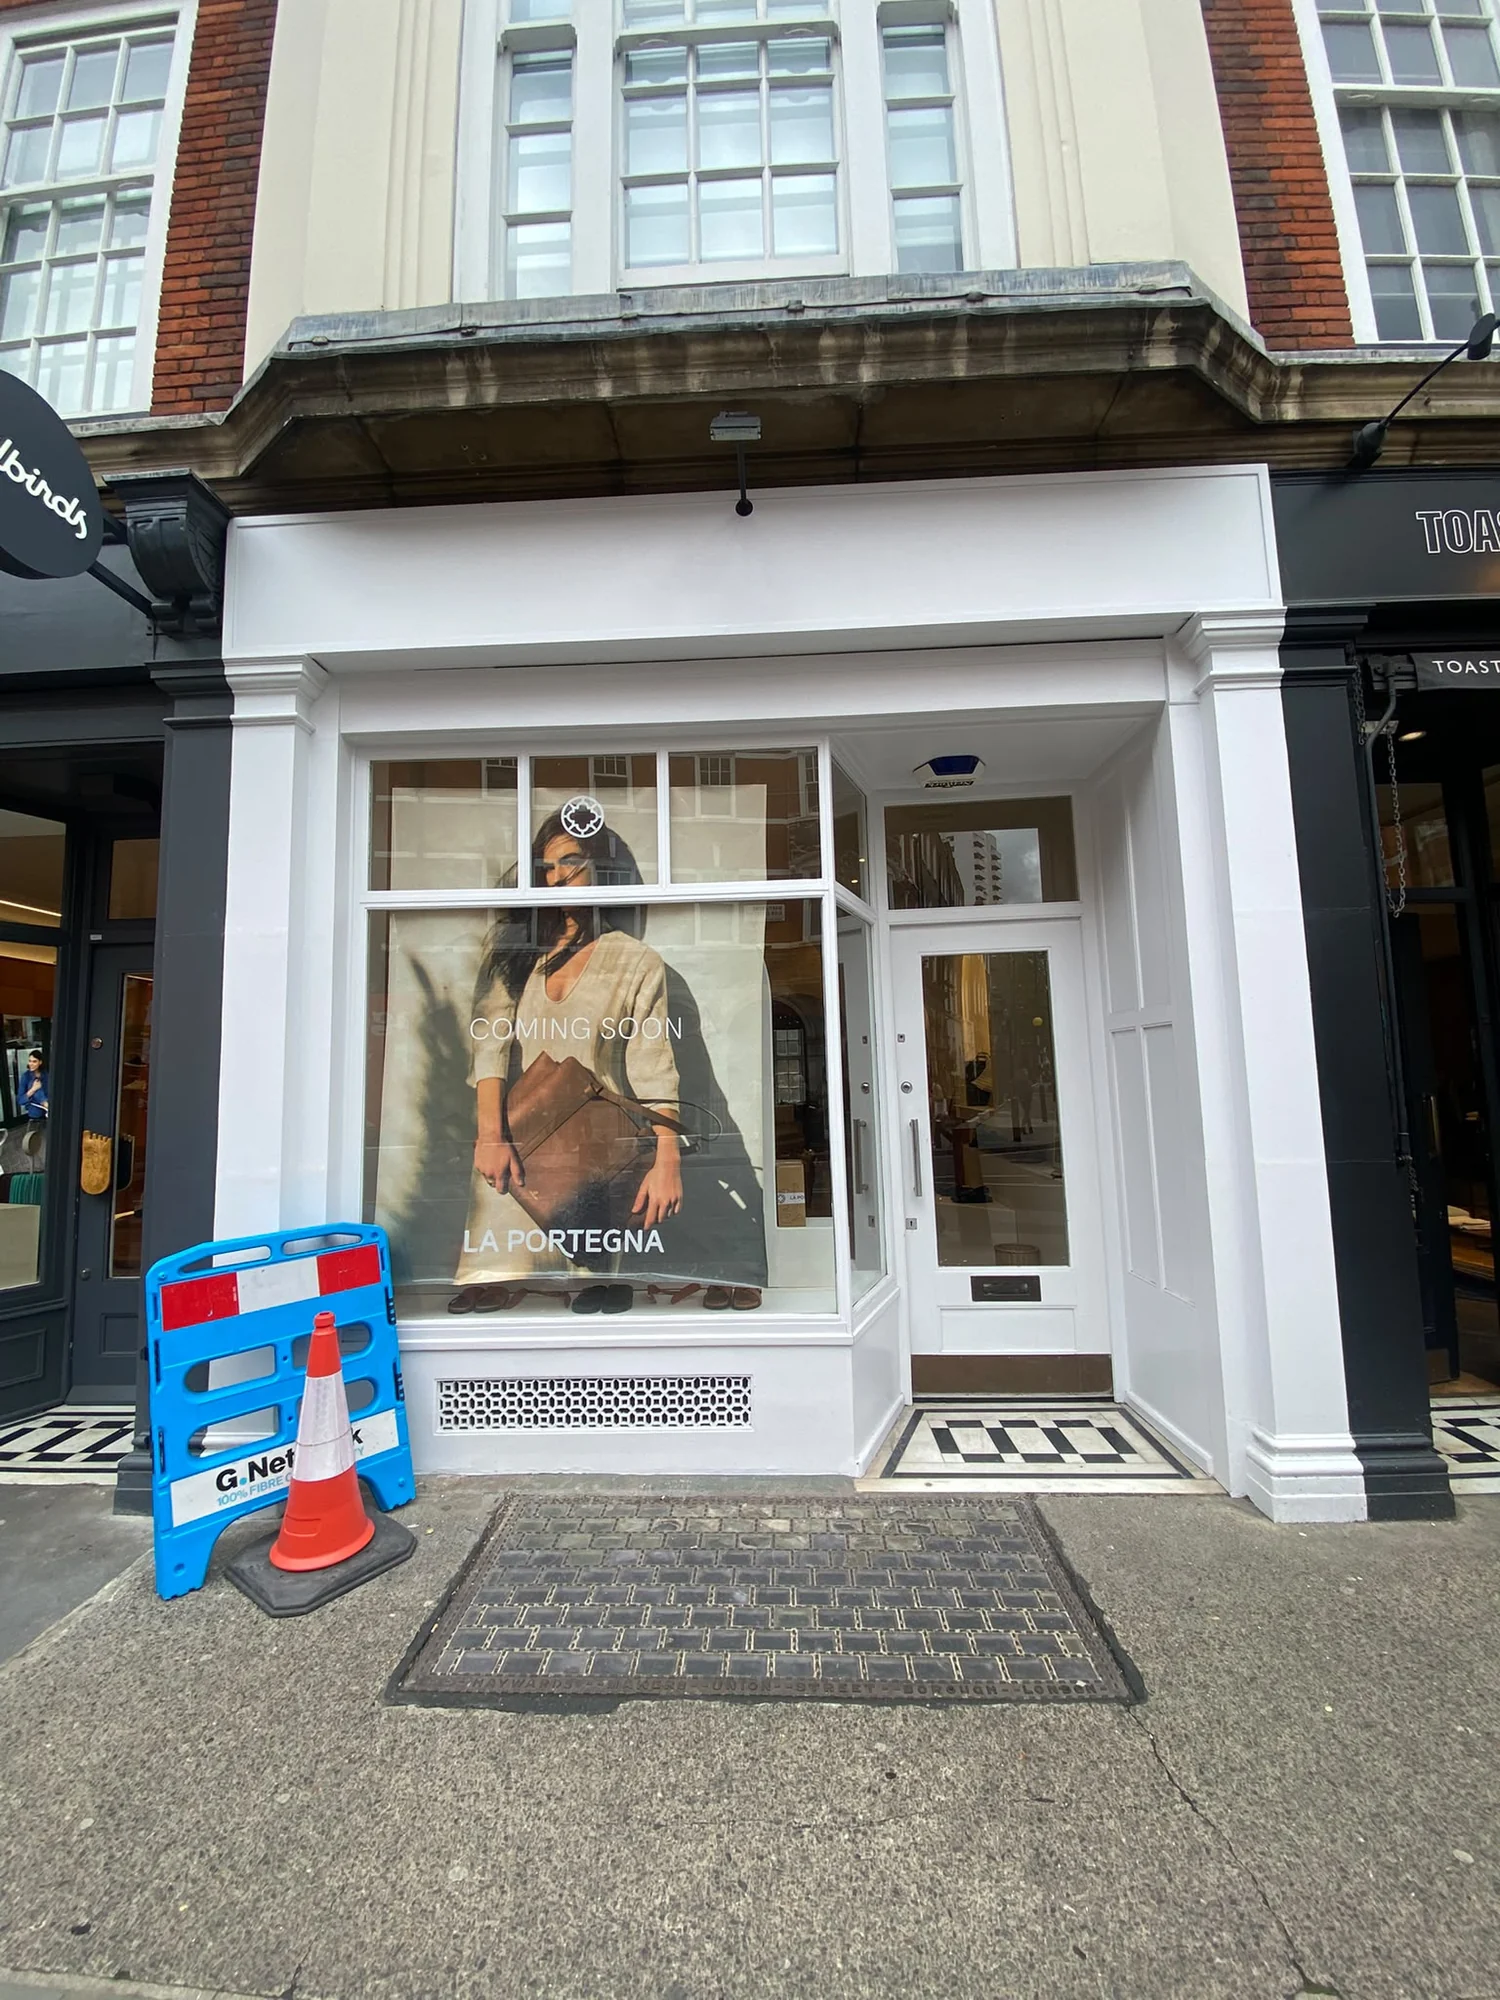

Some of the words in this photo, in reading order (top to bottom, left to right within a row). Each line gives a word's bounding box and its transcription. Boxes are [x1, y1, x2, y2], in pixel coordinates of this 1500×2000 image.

[1416, 509, 1500, 553] TOA
[470, 1017, 591, 1040] COMING
[600, 1017, 682, 1040] SOON
[463, 1229, 499, 1253] LA
[508, 1229, 664, 1258] PORTEGNA
[217, 1490, 248, 1506] 100%
[250, 1475, 283, 1494] FIBRE
[472, 1678, 572, 1690] HAYWARDS
[712, 1679, 771, 1692] UNION
[798, 1680, 876, 1694] STREET
[903, 1681, 998, 1695] BOROUGH
[1023, 1681, 1097, 1695] LONDON
